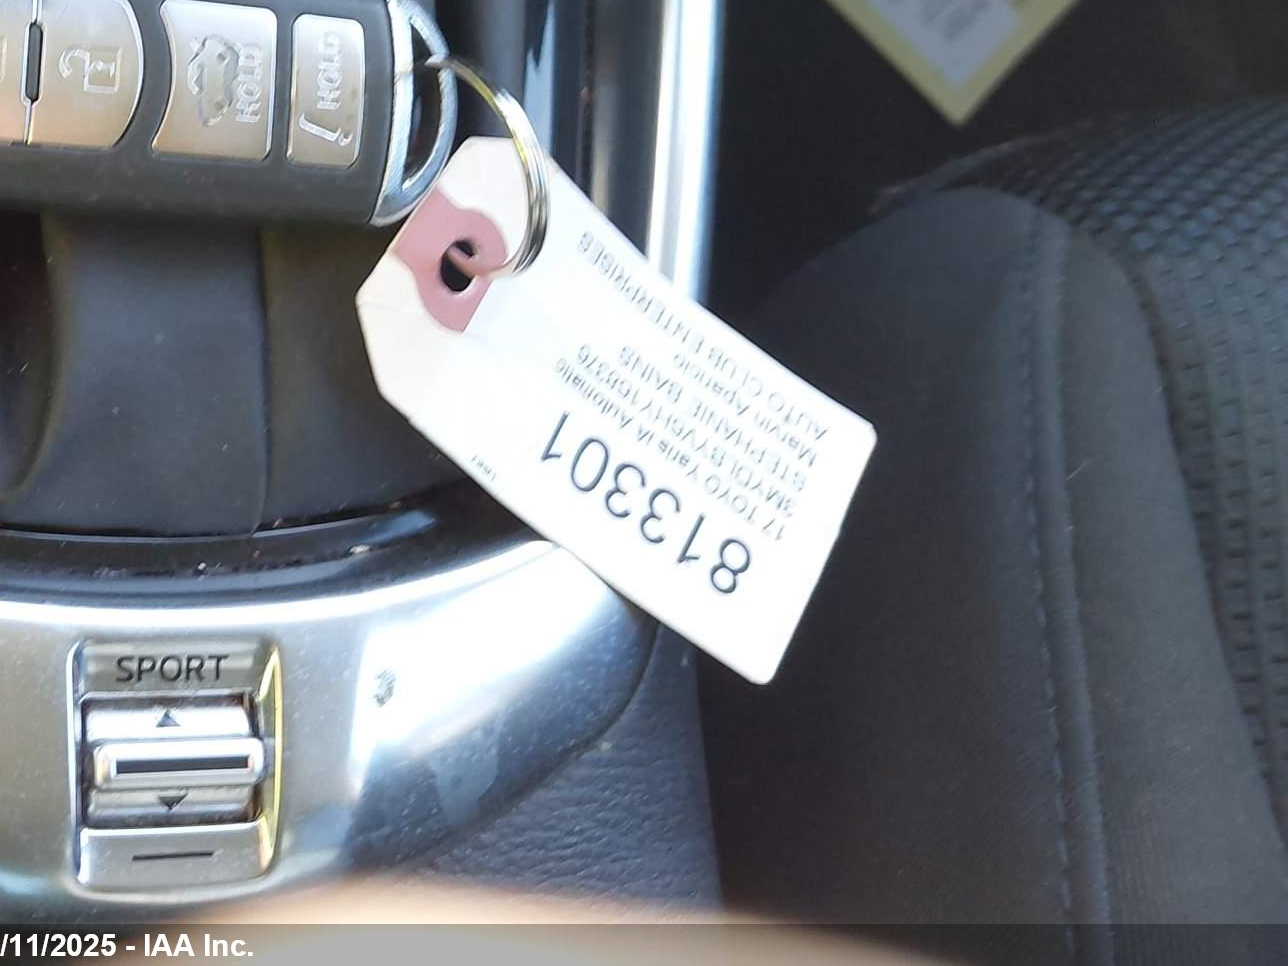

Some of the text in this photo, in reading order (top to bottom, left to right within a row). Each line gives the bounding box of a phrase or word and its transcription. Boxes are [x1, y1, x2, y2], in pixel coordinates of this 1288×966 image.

[234, 41, 264, 123] HOLD
[315, 30, 341, 111] HOLD
[768, 392, 830, 442] AUTO
[540, 411, 752, 596] 813301
[703, 474, 758, 525] TOYO
[116, 654, 230, 683] SPORT
